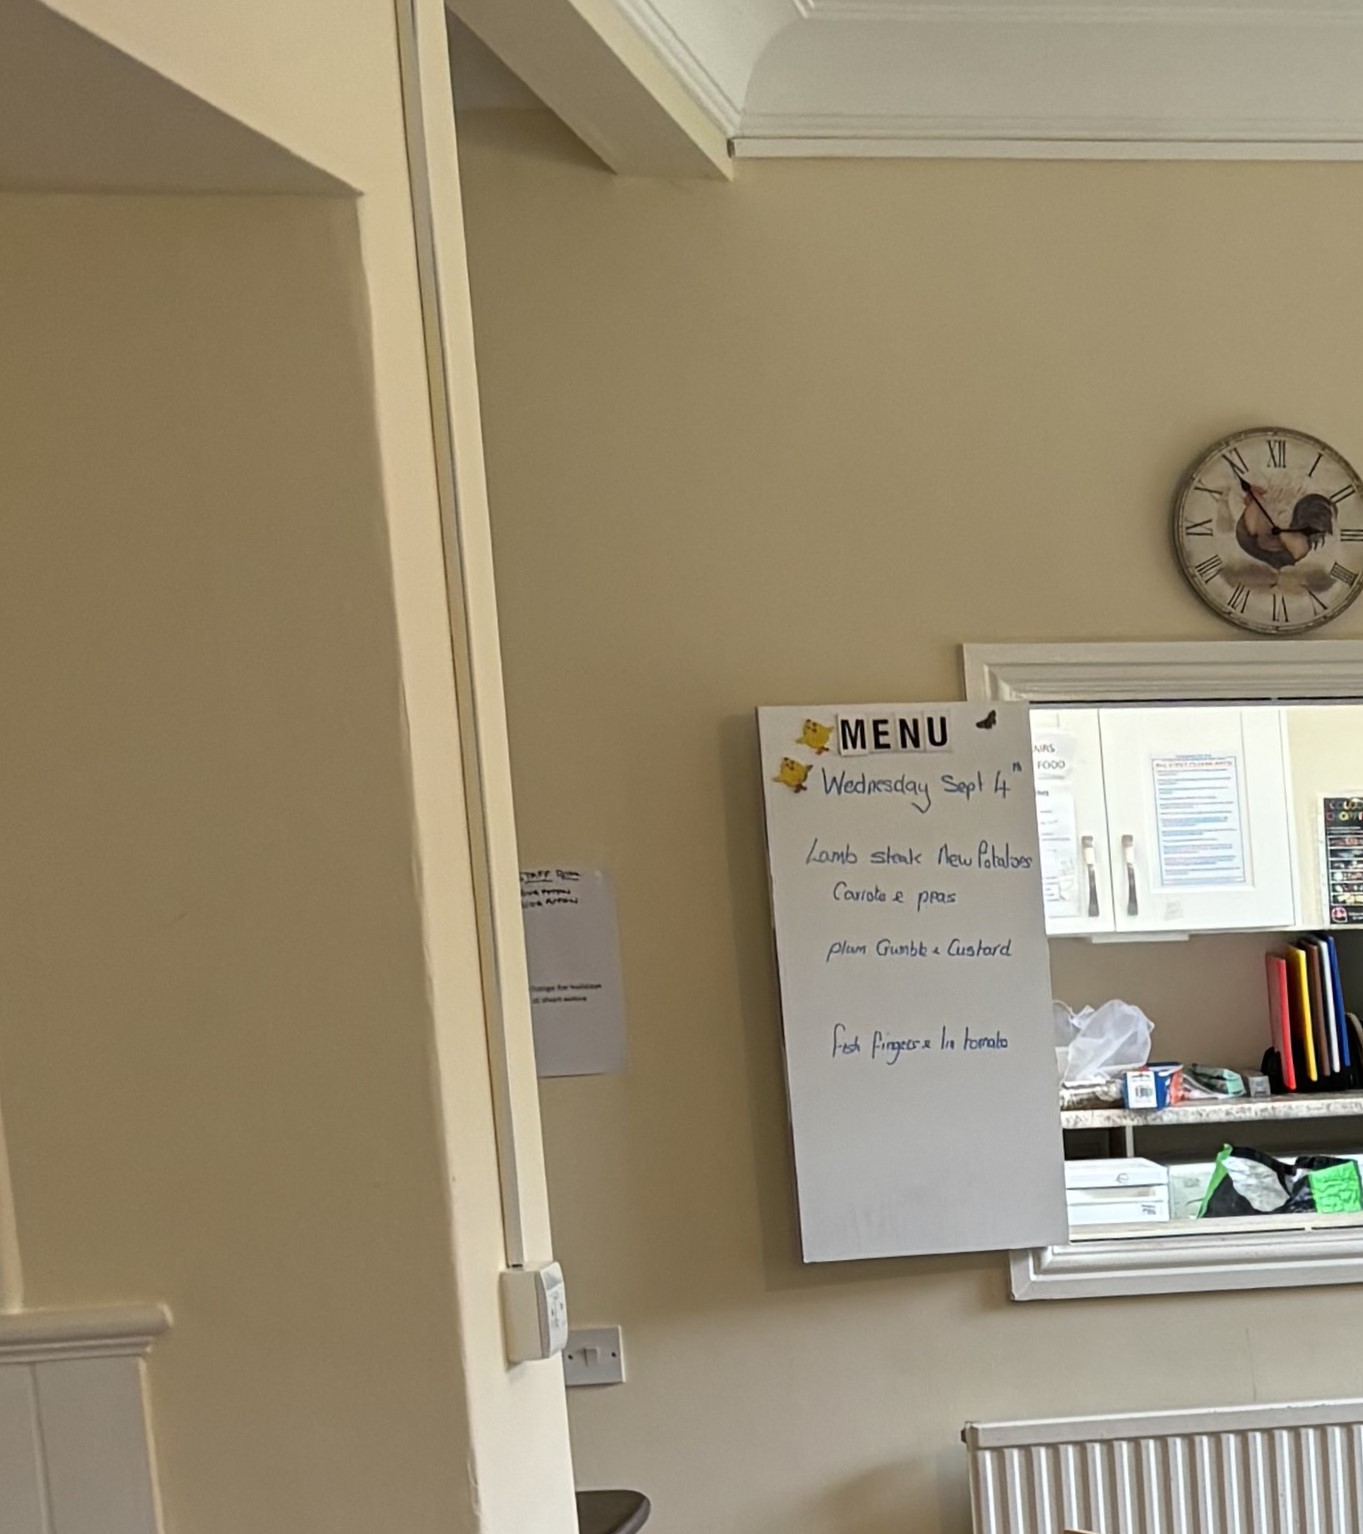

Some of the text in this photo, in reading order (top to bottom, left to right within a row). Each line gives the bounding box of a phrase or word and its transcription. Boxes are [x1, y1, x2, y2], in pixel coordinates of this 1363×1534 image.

[840, 717, 948, 750] MENU
[821, 767, 932, 814] Wednesday
[941, 770, 984, 801] Sept
[805, 837, 858, 865] Lamb
[938, 843, 972, 868] New
[947, 938, 1013, 957] Custard
